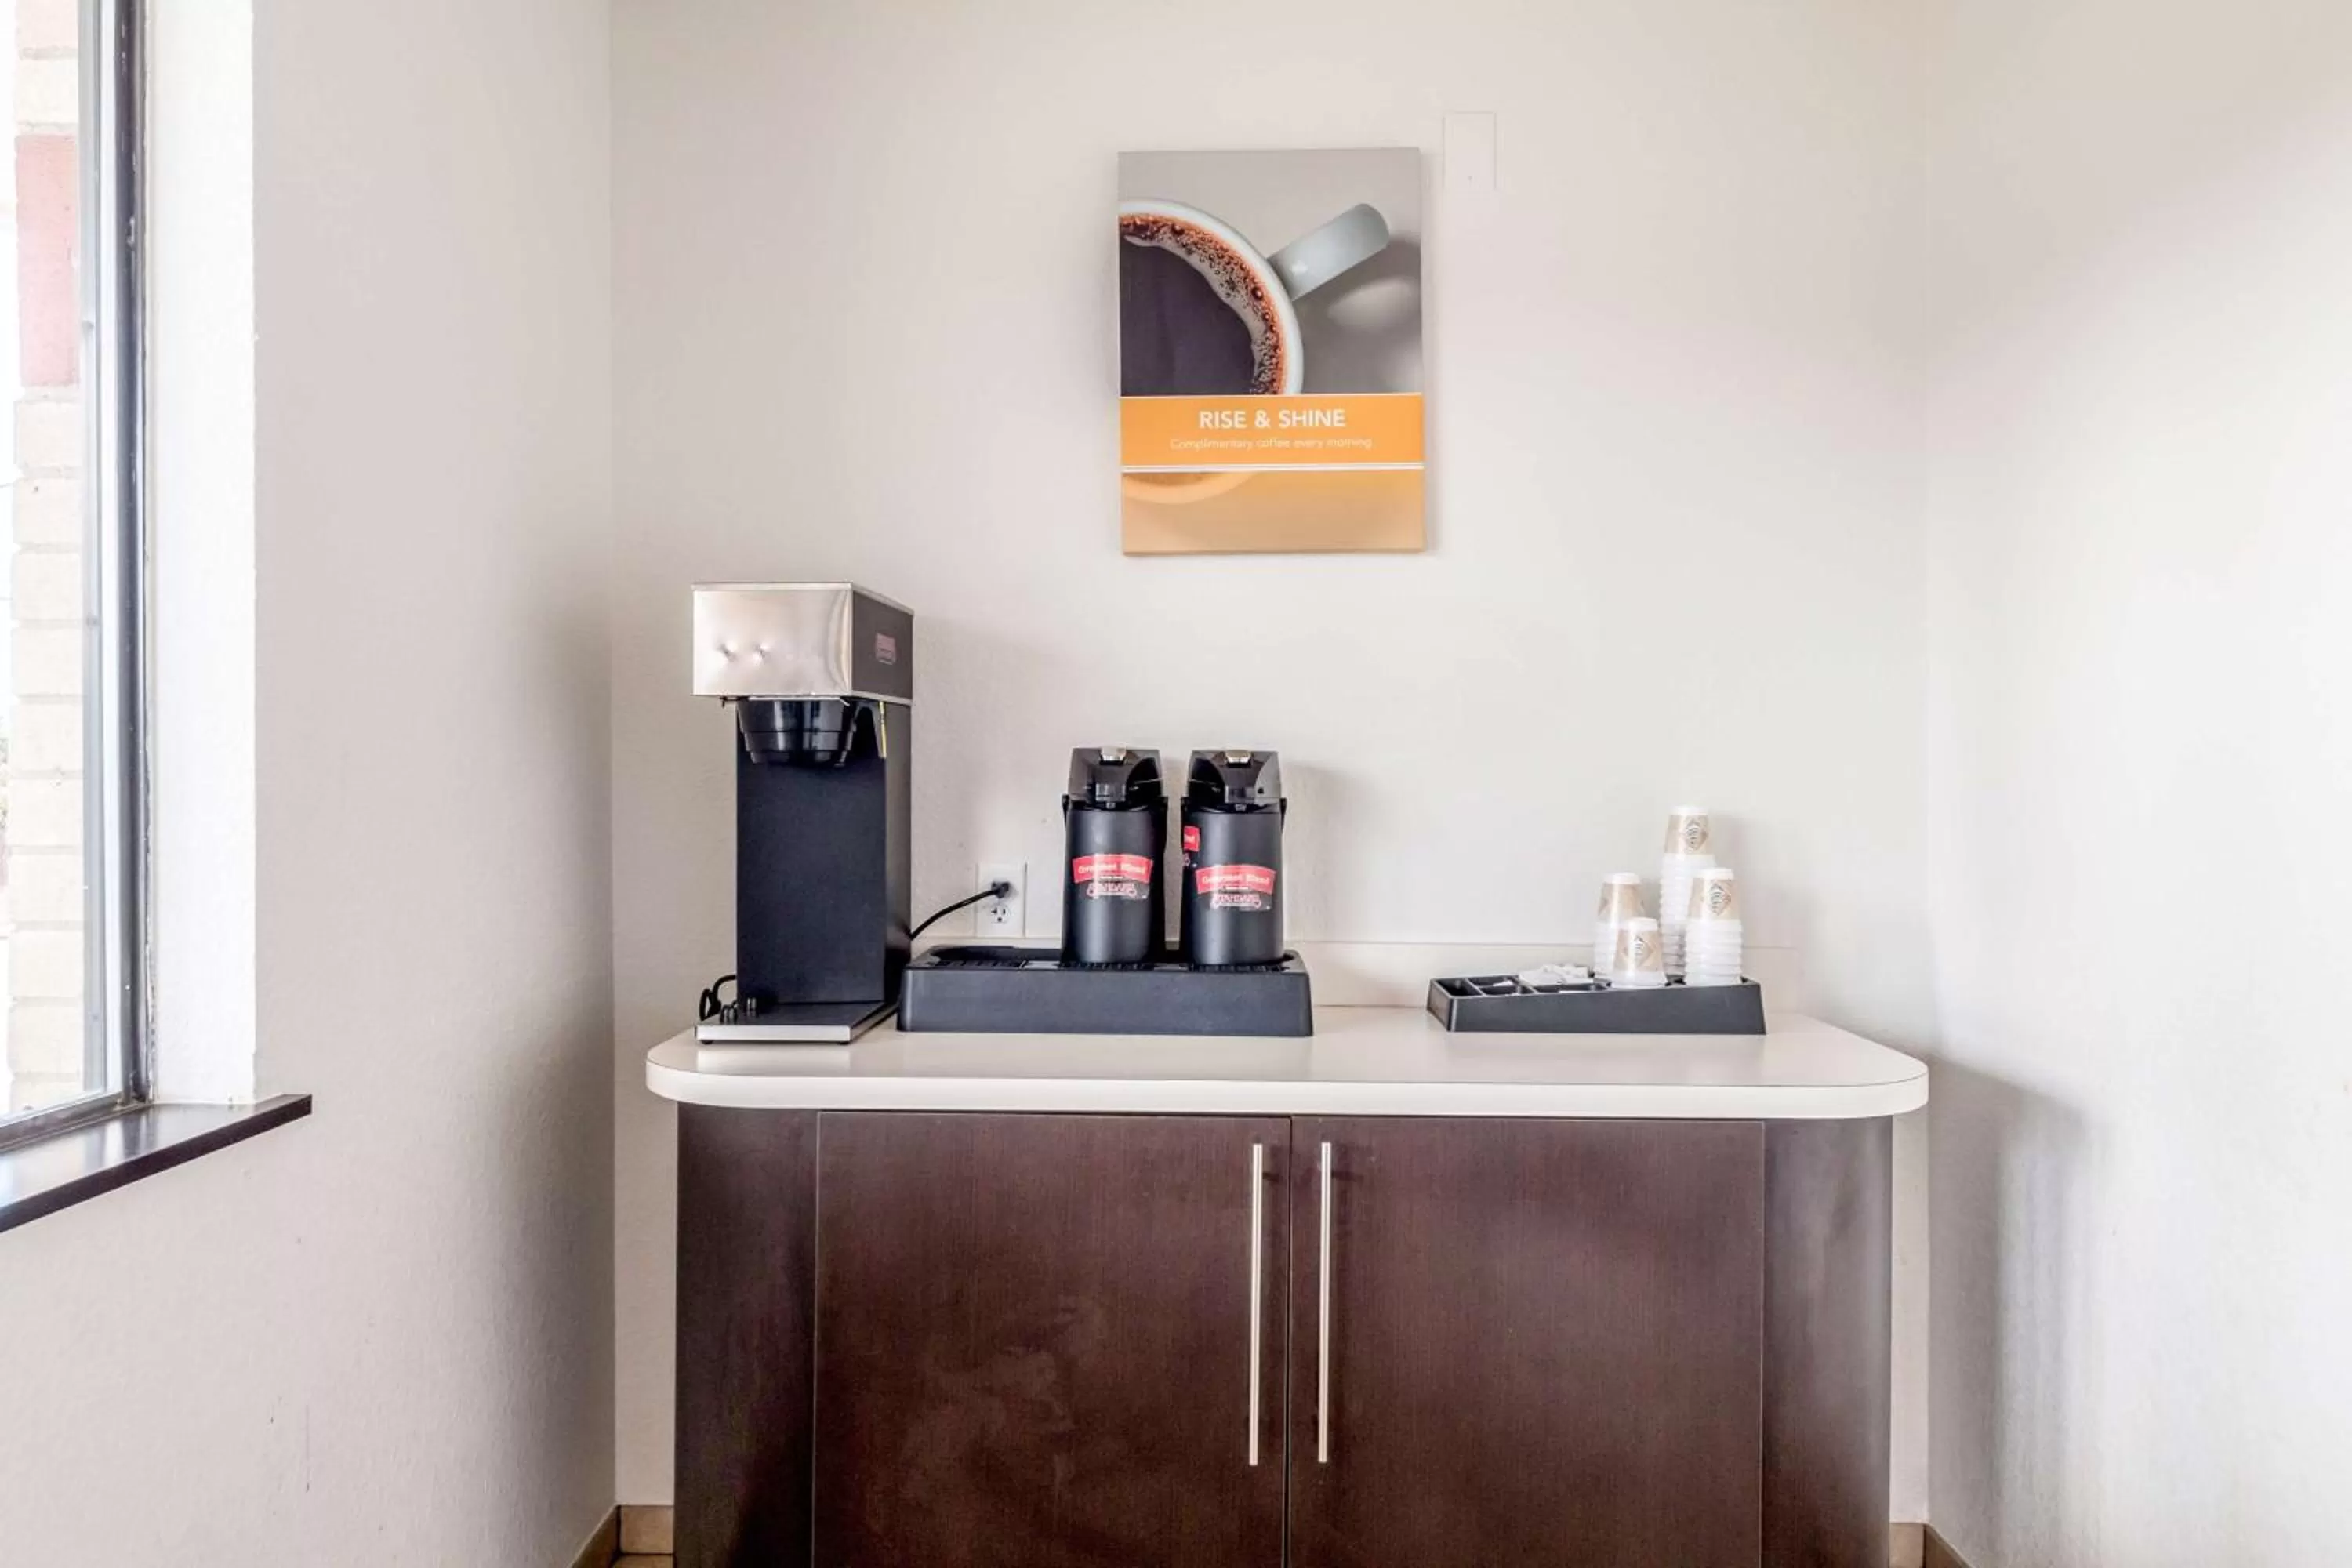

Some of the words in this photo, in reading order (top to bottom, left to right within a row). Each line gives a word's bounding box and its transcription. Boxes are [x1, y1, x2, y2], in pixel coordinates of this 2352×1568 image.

[1199, 410, 1247, 429] RISE
[1254, 409, 1270, 429] &
[1279, 408, 1346, 428] SHINE
[1170, 438, 1254, 452] Complimentary
[1255, 437, 1290, 449] coffee
[1293, 439, 1326, 450] every
[1326, 437, 1372, 449] morning
